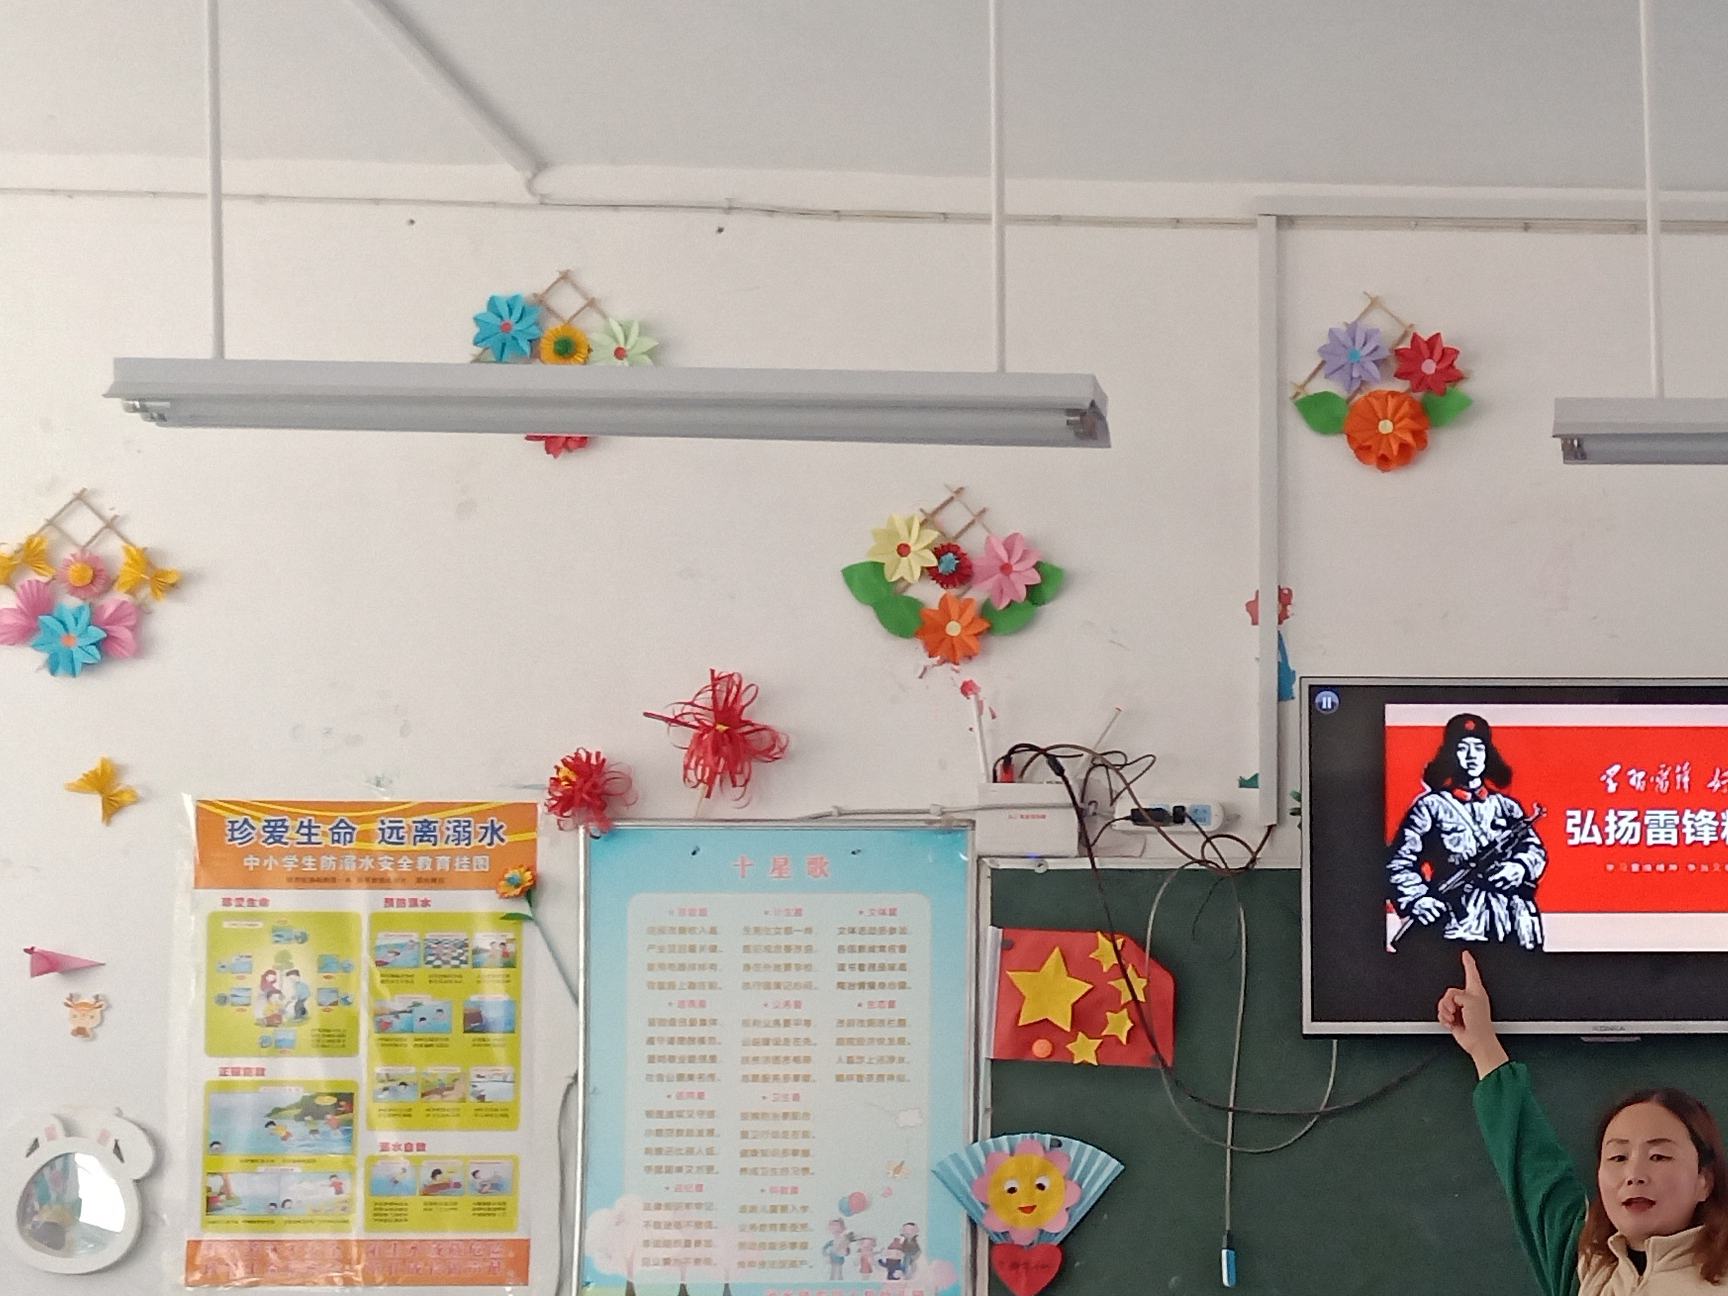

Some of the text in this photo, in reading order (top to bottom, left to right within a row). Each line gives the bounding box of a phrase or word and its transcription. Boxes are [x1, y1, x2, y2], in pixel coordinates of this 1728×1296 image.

[226, 817, 508, 847] 珍爱生命 远离溺水
[243, 853, 491, 872] 中小学生防溺水安全教育挂图
[733, 855, 830, 879] 十星歌
